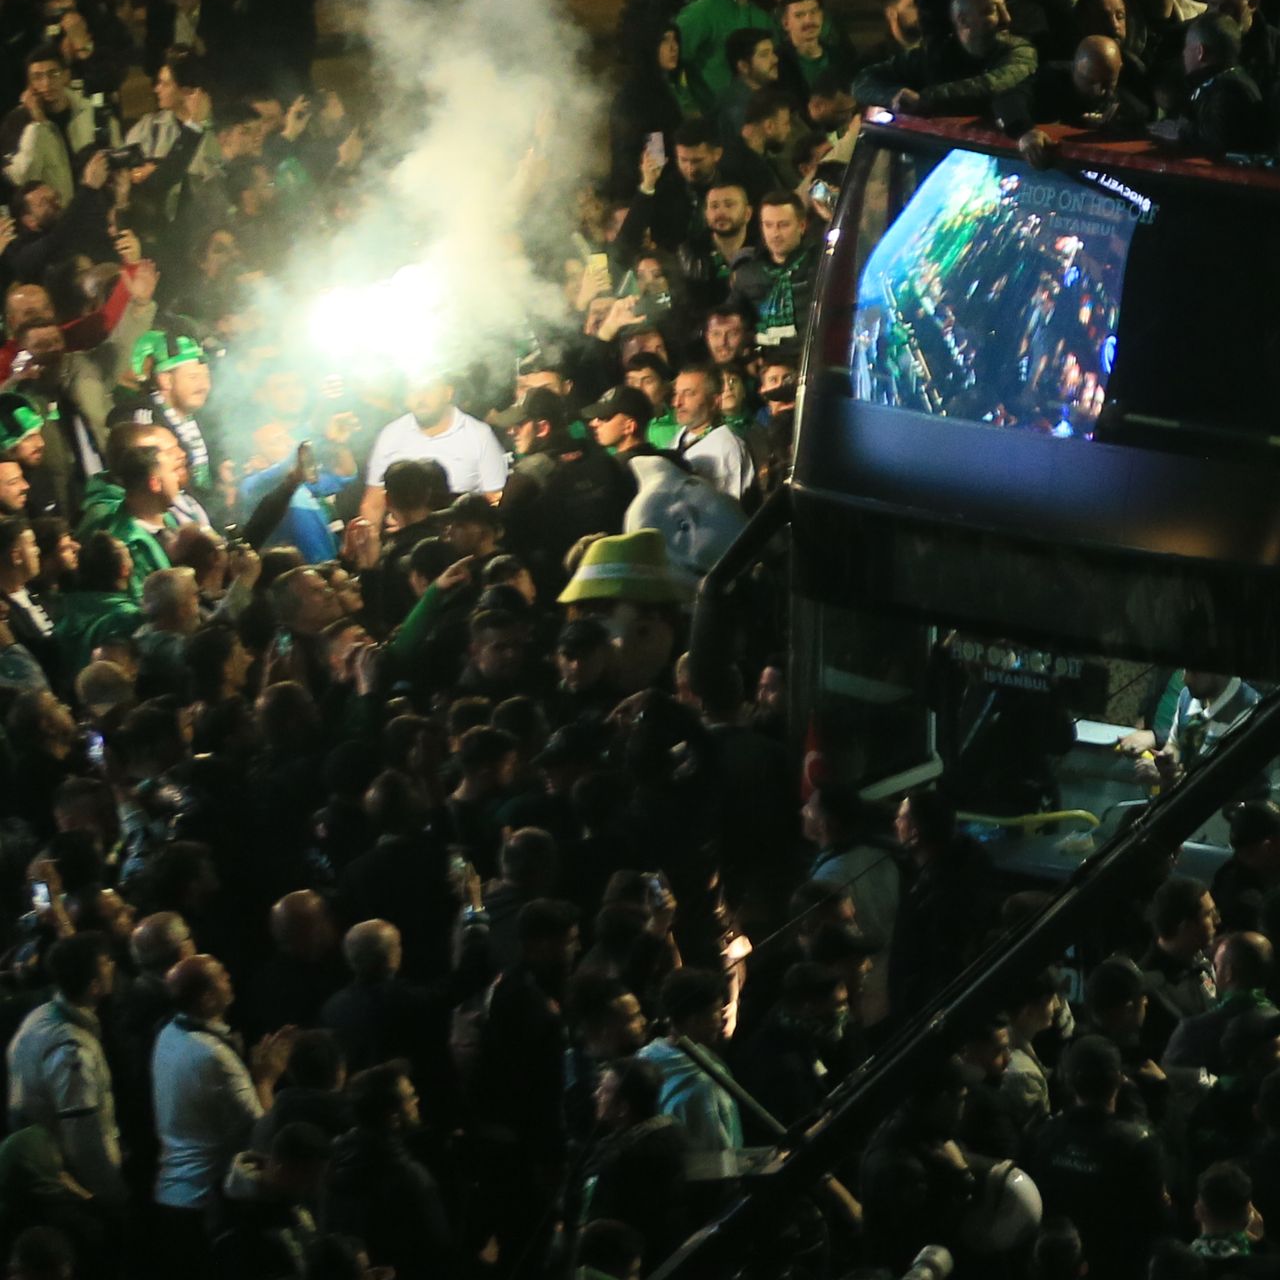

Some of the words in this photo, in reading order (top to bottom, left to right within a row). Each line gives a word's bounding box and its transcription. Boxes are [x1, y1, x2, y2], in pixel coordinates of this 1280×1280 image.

[1021, 184, 1055, 207] HOP
[1059, 189, 1085, 211] ON
[1091, 195, 1125, 218] HOP
